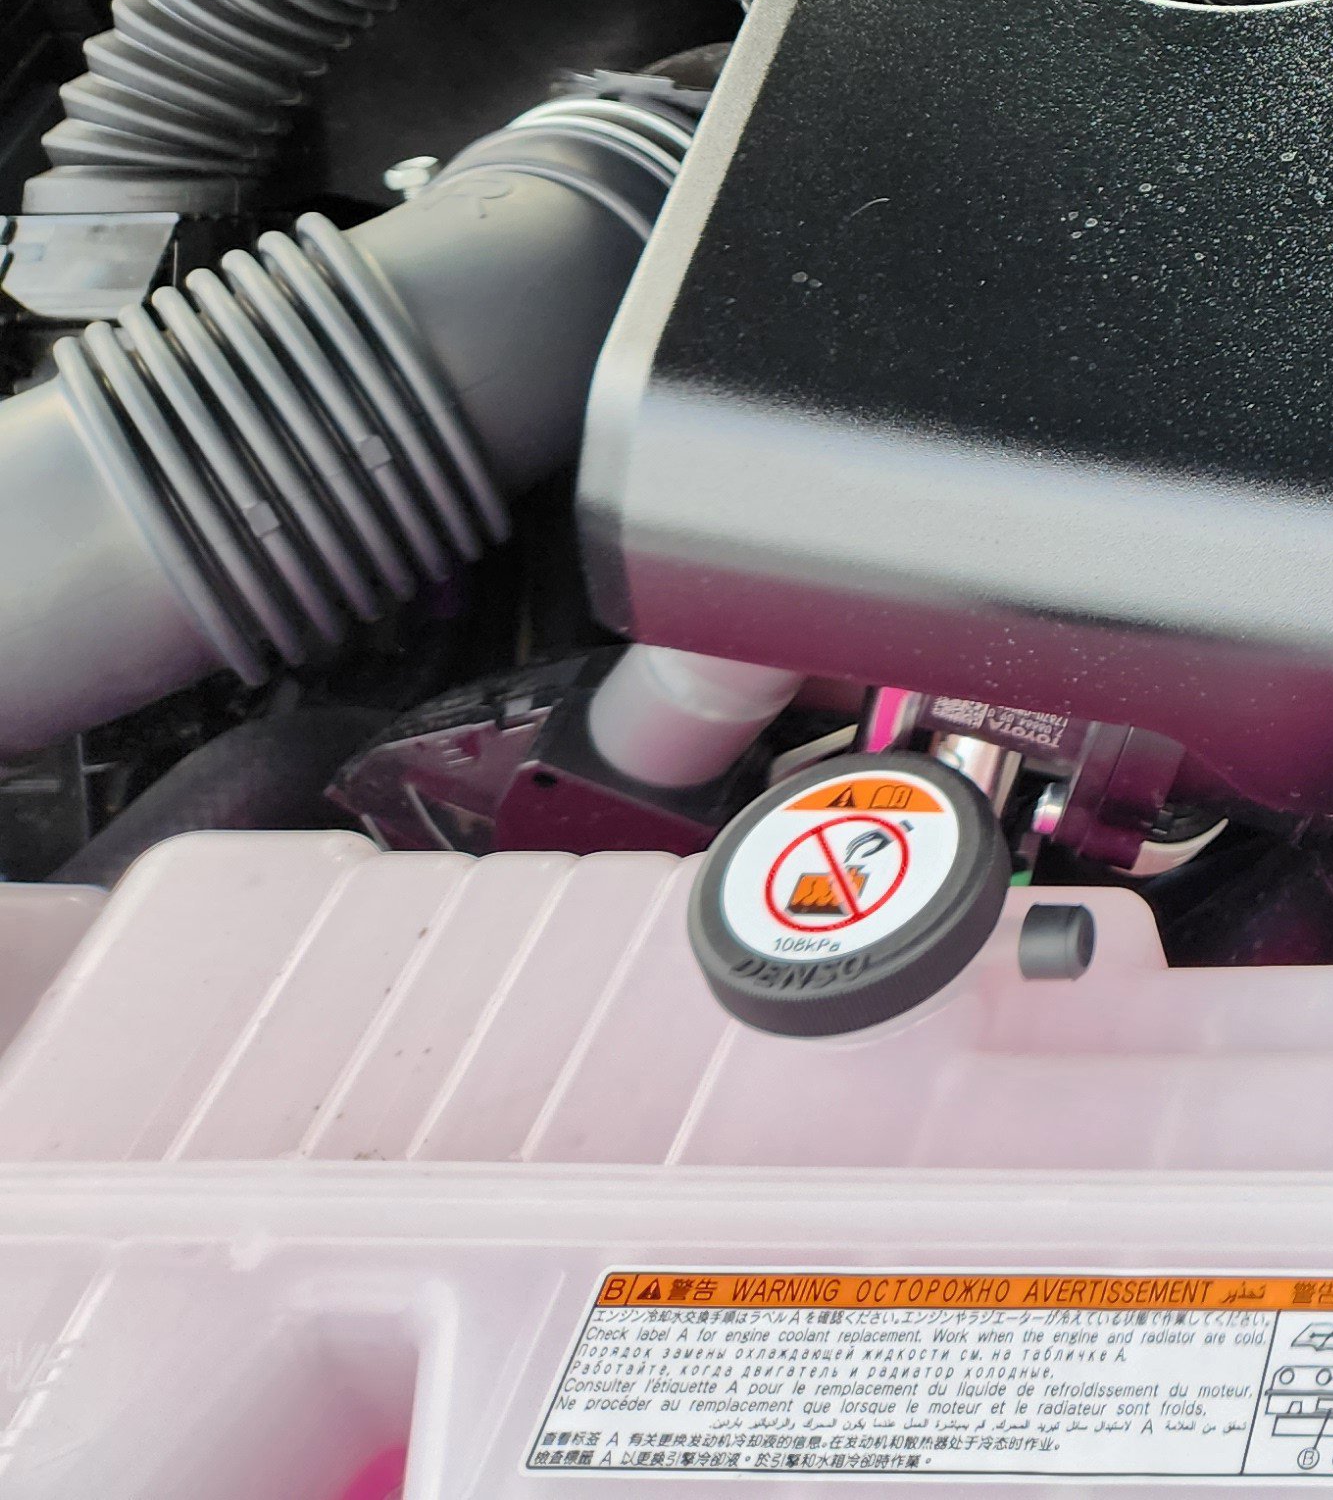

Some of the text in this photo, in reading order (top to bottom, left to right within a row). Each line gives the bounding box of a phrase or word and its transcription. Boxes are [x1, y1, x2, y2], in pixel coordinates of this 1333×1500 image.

[987, 719, 1060, 749] TOYOTA
[729, 953, 872, 991] DENSO
[604, 1278, 626, 1301] B
[667, 1278, 719, 1301] 警告
[732, 1278, 841, 1303] WARNING
[856, 1279, 1010, 1303] ОСТОРОЖНО
[1023, 1278, 1214, 1304] AVERTISSEMENT
[586, 1326, 1267, 1345] Check label A for engine coolant replacement. Work when the engine and radiator are cold.
[577, 1343, 653, 1359] Порядок
[663, 1347, 726, 1359] замены
[735, 1345, 855, 1361] охлаждающей
[862, 1348, 950, 1361] жидкости
[960, 1348, 983, 1361] см.
[992, 1348, 1011, 1361] на
[1023, 1345, 1108, 1362] табличке
[680, 1362, 733, 1376] когда
[741, 1364, 838, 1379] двигатель
[848, 1367, 858, 1378] и
[867, 1366, 954, 1380] радиатор
[564, 1377, 636, 1393] Consulter
[644, 1378, 717, 1395] l'étiquette
[725, 1381, 737, 1393] A
[748, 1382, 784, 1396] pour
[792, 1381, 806, 1394] le
[814, 1381, 918, 1397] remplacement
[928, 1382, 948, 1396] du
[957, 1382, 1007, 1398] liquide
[1017, 1382, 1035, 1397] de
[1044, 1382, 1159, 1397] refroidissement
[1169, 1383, 1188, 1398] du
[555, 1395, 1207, 1417] Ne procéder au remplacement que lorsque le moteur et le radiateur sont froids.
[1140, 1418, 1154, 1435] A
[606, 1431, 619, 1447] A
[599, 1450, 612, 1466] A
